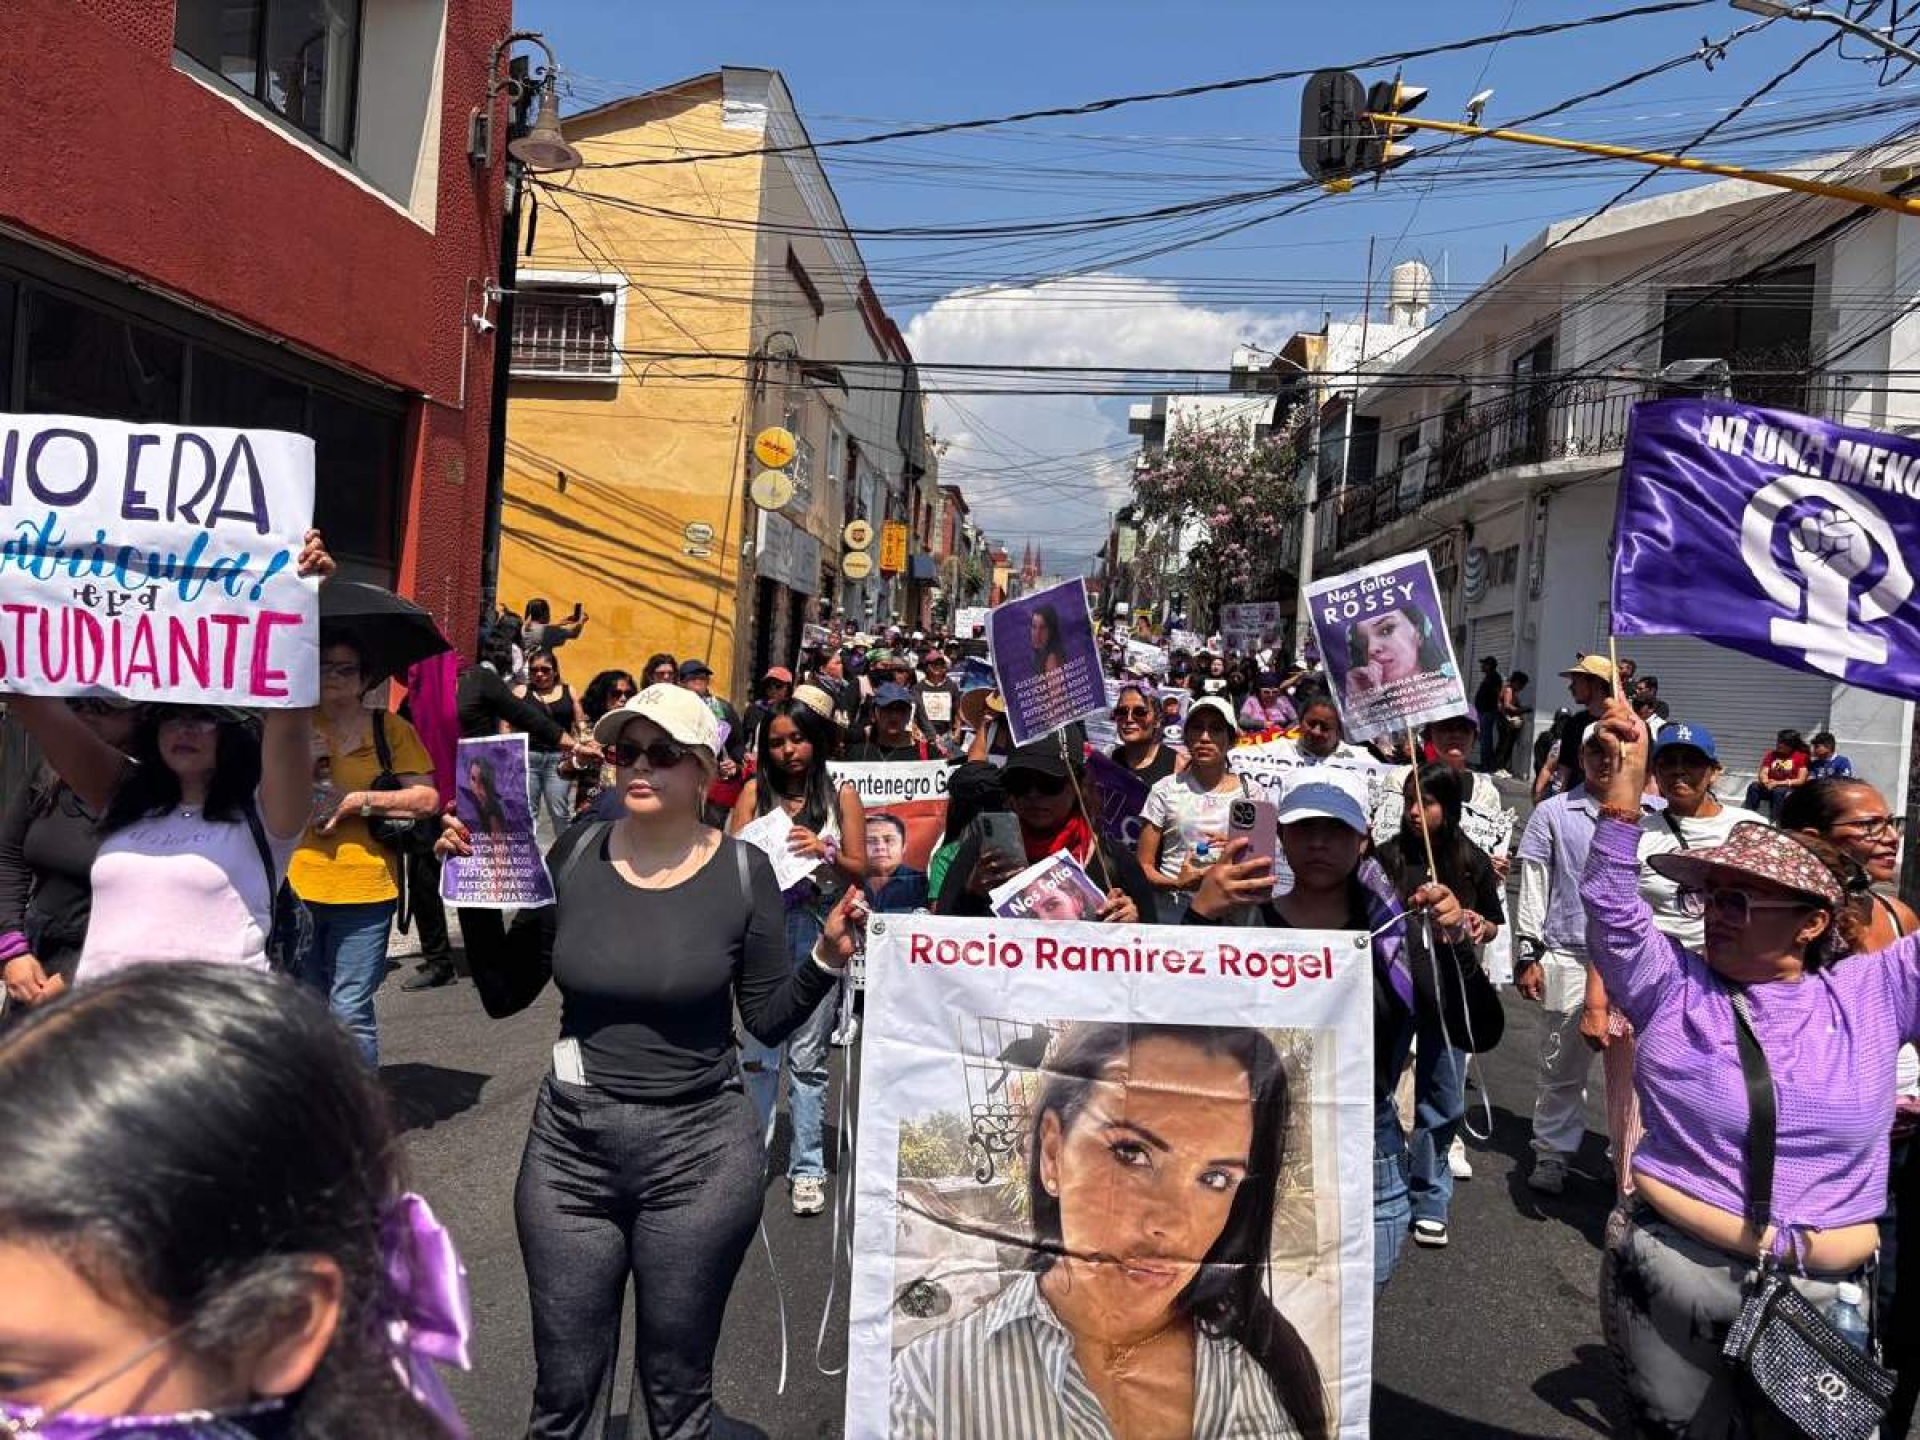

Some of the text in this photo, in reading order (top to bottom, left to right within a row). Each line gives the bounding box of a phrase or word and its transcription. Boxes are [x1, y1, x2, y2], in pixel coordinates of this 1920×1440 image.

[1709, 415, 1749, 456] NI
[1753, 424, 1824, 477] UNA
[121, 433, 270, 534] ERA
[1323, 581, 1414, 625] ROSSY
[1327, 588, 1358, 604] Nos
[1009, 890, 1041, 916] Nos
[909, 933, 1334, 989] Rocio Ramirez Rogel
